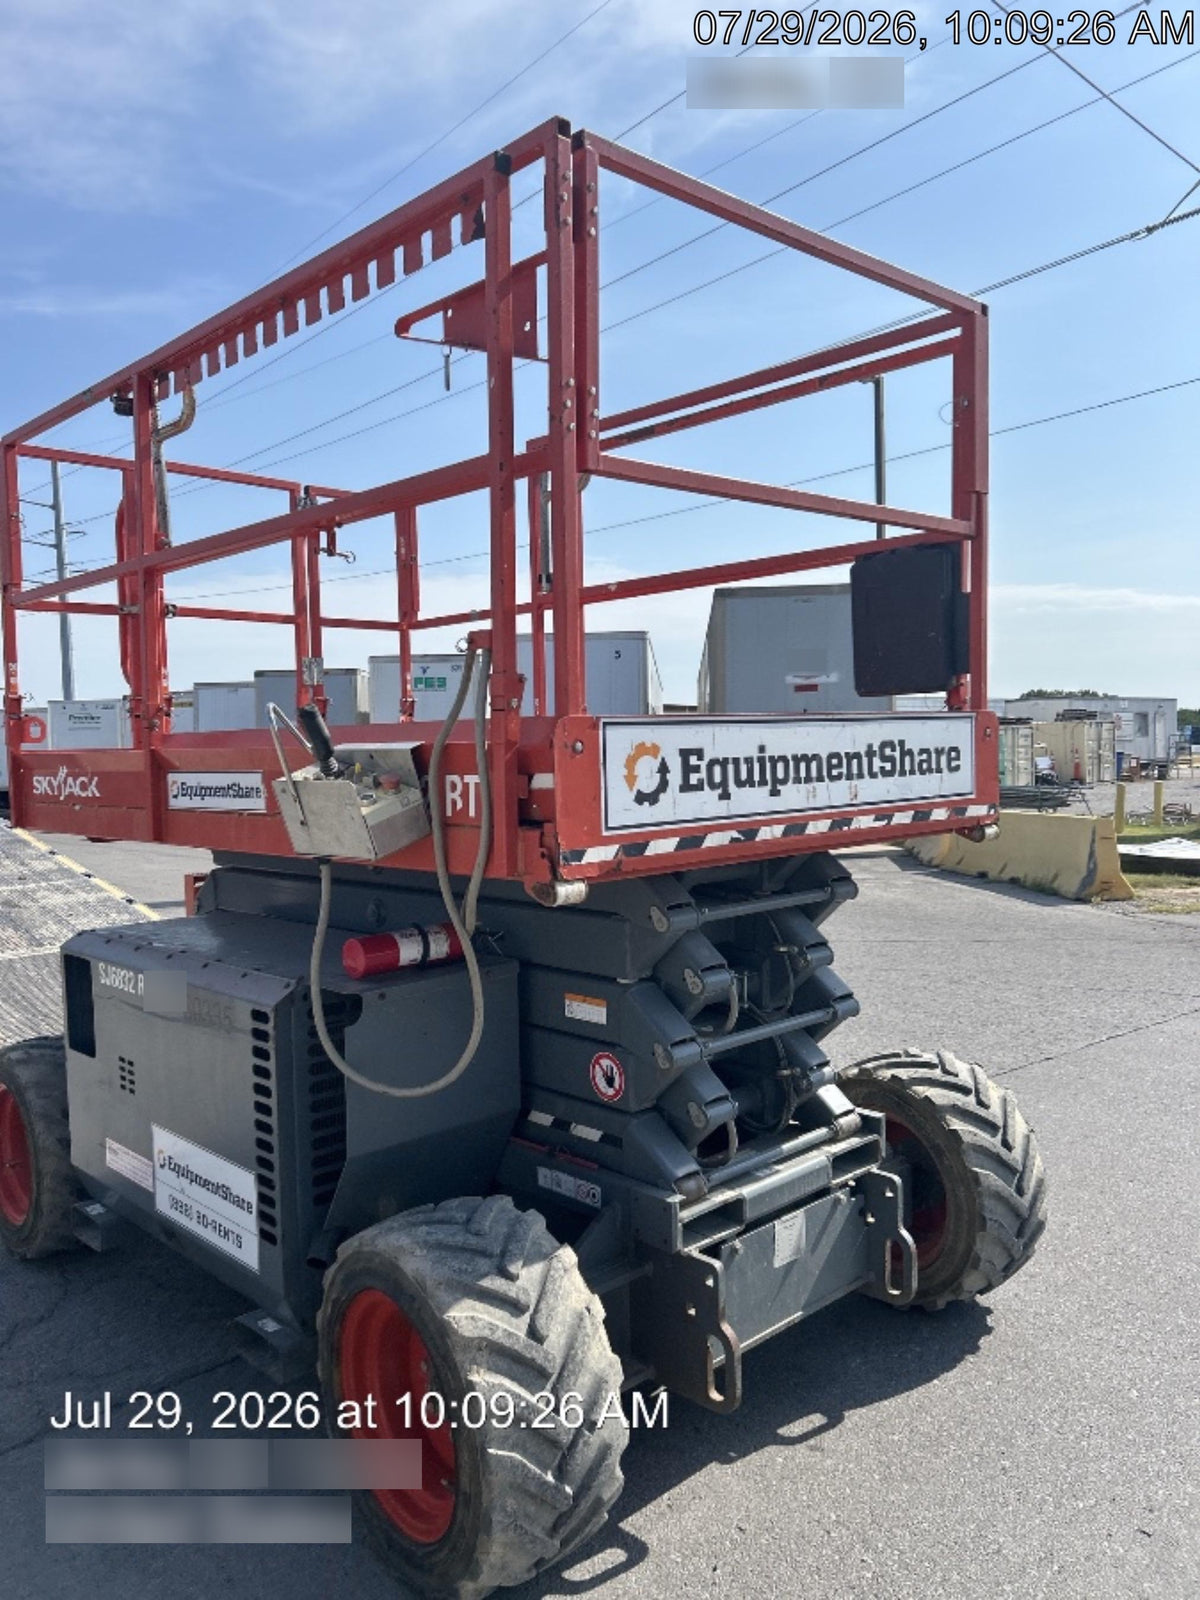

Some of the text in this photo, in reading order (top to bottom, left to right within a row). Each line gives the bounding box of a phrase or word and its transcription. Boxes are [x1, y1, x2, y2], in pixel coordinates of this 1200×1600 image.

[32, 766, 100, 800] SKYJACK
[678, 739, 962, 801] EquipmentShare
[180, 781, 262, 801] EquipmentShare
[445, 774, 481, 818] RT
[98, 962, 136, 994] SJ6832
[168, 1155, 253, 1215] EquipmentShare
